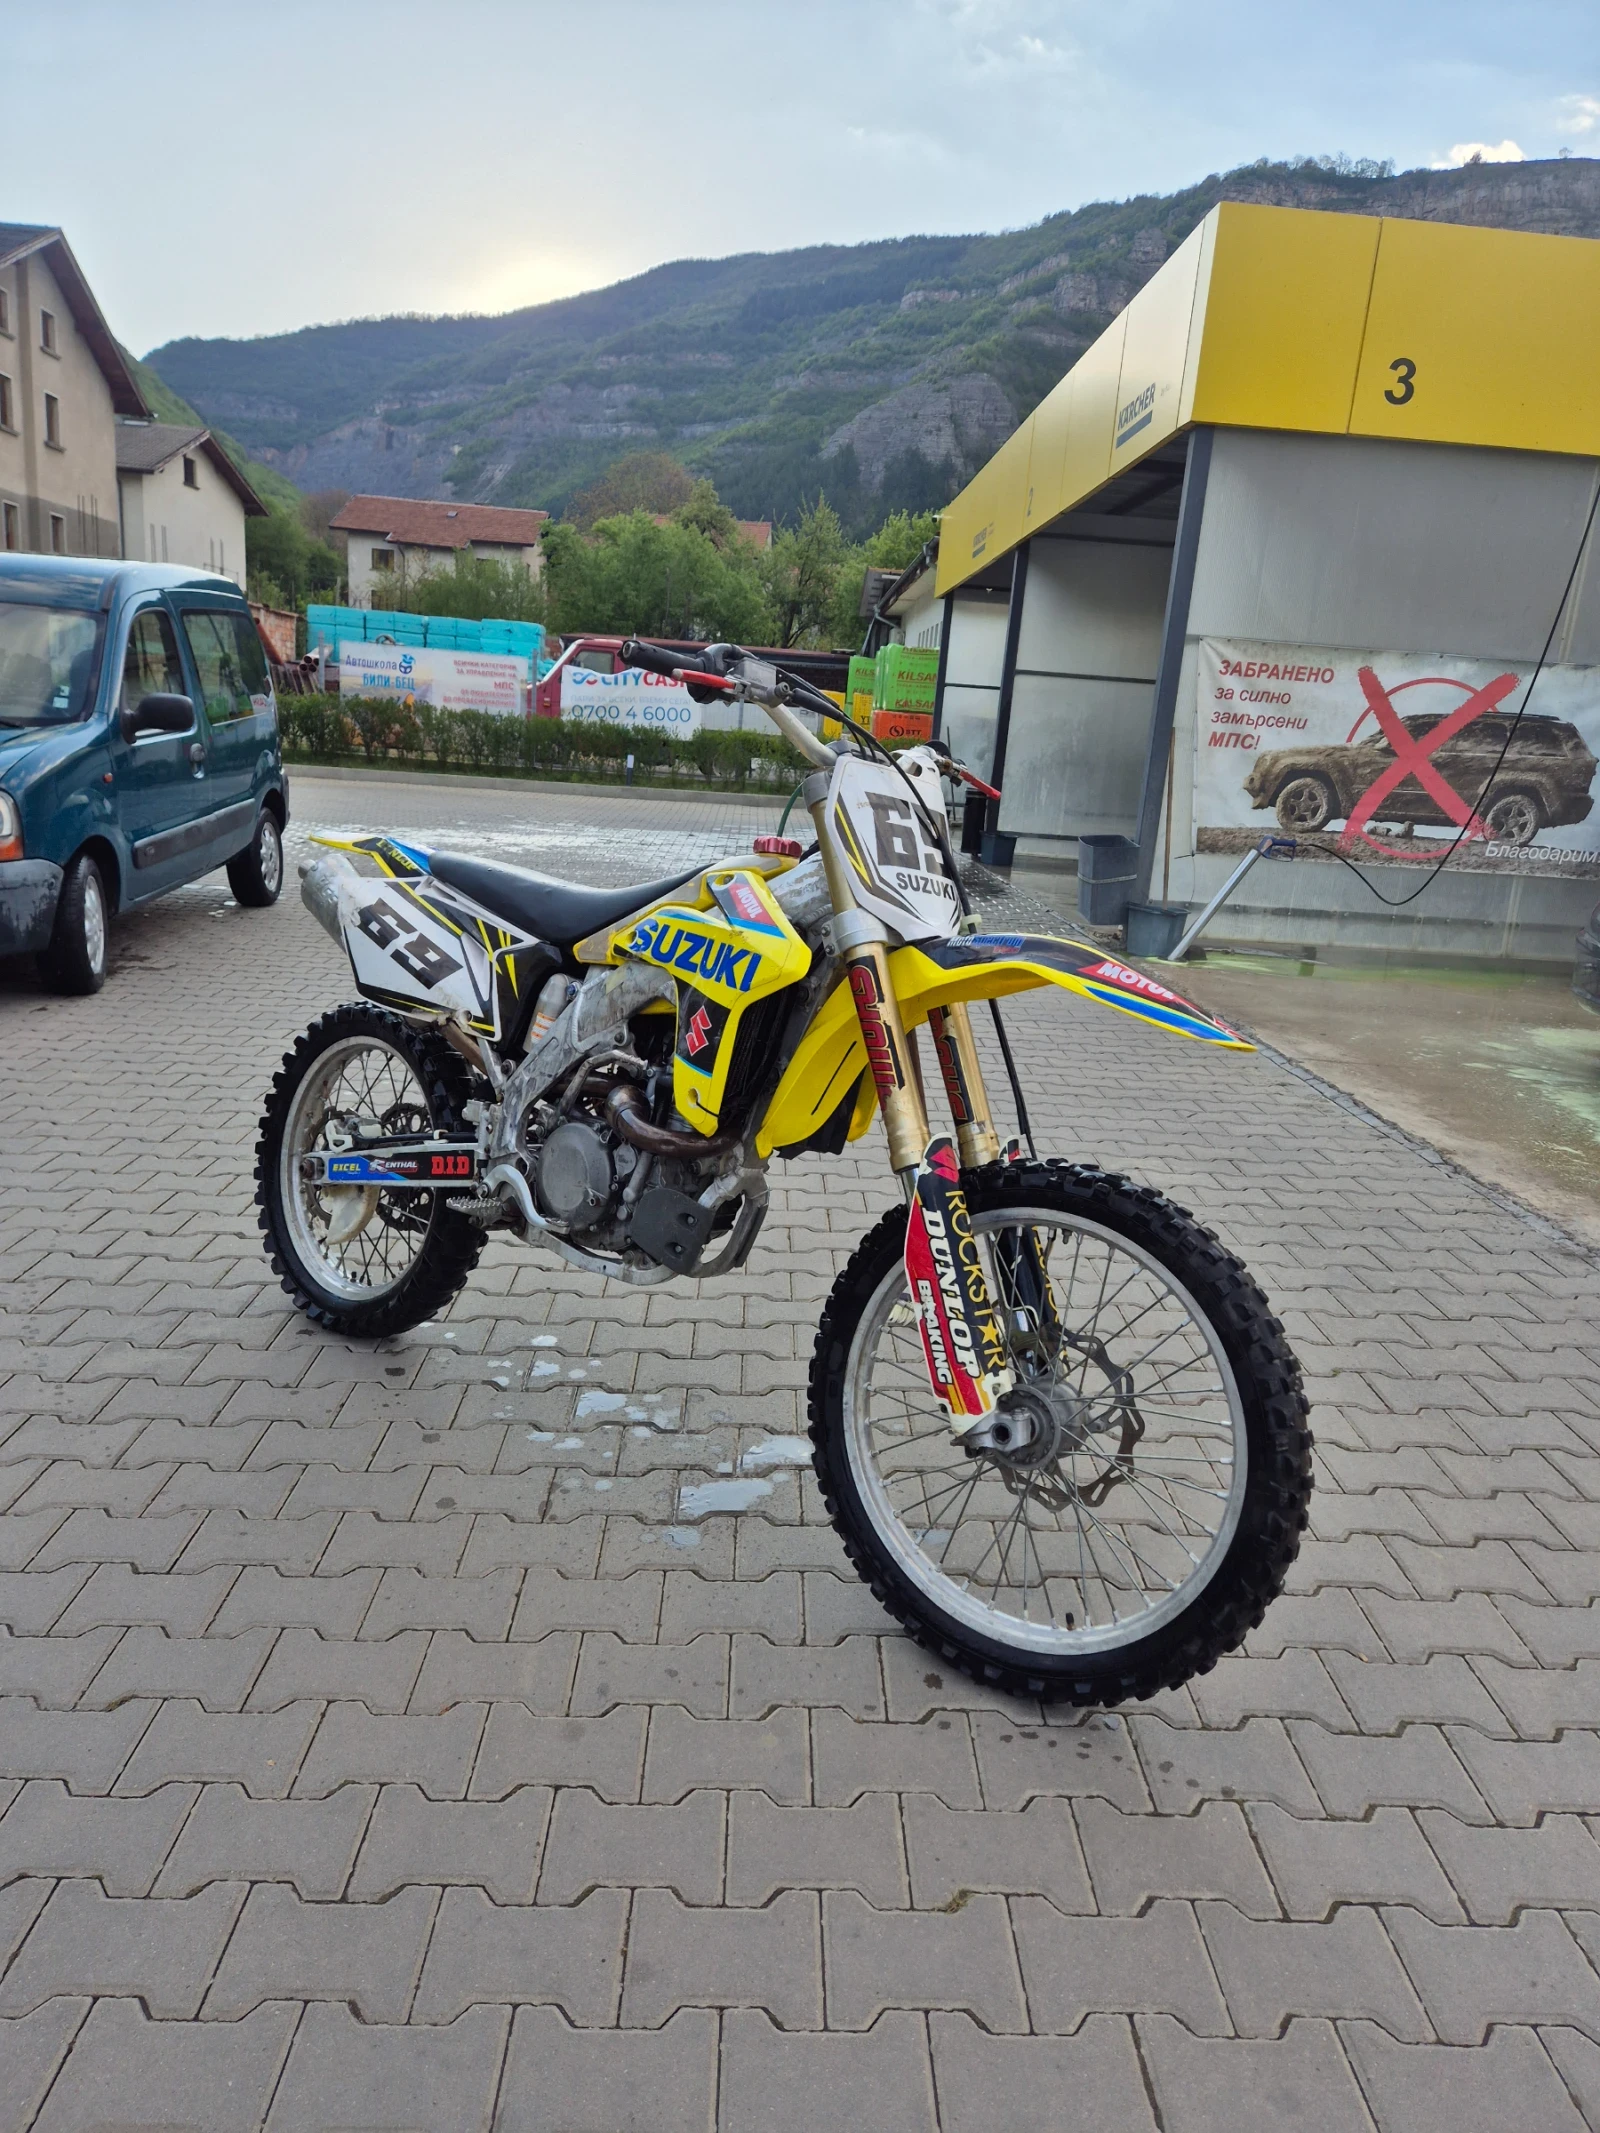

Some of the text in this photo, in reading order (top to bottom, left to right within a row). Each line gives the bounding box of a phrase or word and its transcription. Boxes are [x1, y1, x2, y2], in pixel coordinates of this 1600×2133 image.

[1384, 357, 1417, 406] 3
[345, 654, 397, 670] Автошкола
[1218, 659, 1335, 684] ЗАБРАНЕНО
[493, 680, 515, 691] МПС
[601, 671, 685, 688] CITYCAS
[1214, 687, 1292, 705] за силно
[571, 704, 692, 723] 0700 4 6000
[1210, 711, 1309, 730] замърсени
[1207, 731, 1262, 751] МПС!
[1485, 840, 1600, 865] Благодарим
[895, 872, 956, 902] SUZUKI
[735, 886, 765, 919] MOTUL
[356, 897, 464, 990] 69
[628, 918, 762, 993] SUZUKI
[332, 1163, 361, 1172] EXCEL
[922, 1207, 982, 1379] DUNLOP
